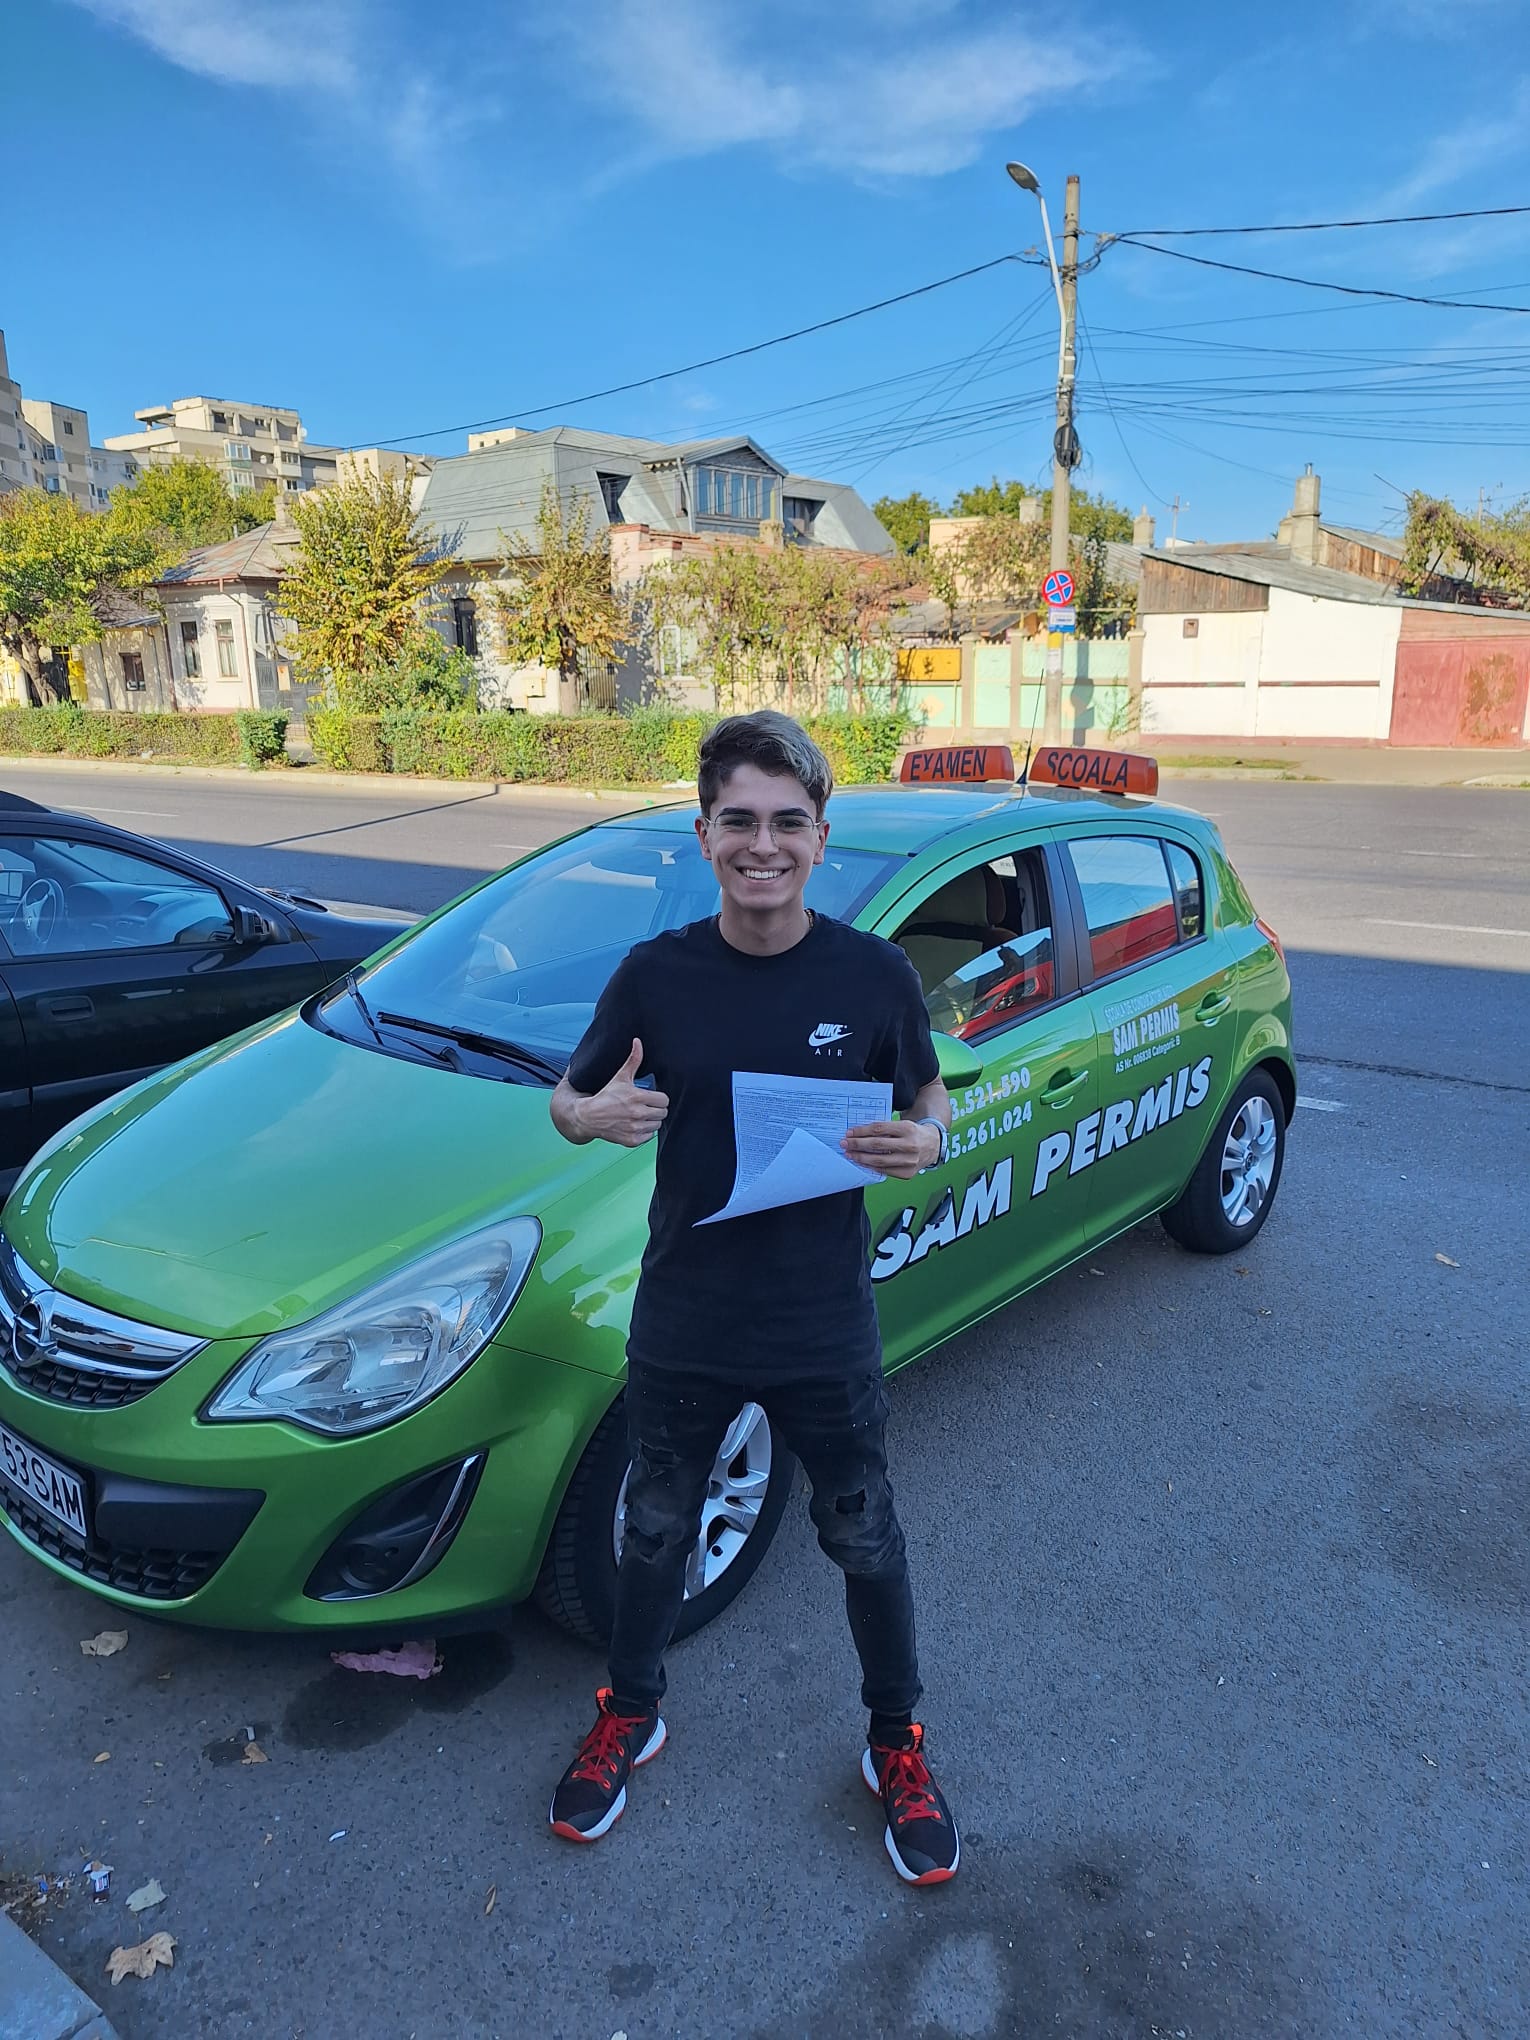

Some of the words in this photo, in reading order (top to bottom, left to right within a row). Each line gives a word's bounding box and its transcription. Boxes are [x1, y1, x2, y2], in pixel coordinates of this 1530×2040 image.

[910, 748, 988, 781] EXAMEN
[815, 1022, 844, 1037] NIKE
[1113, 1020, 1139, 1057] SAM
[1140, 1002, 1180, 1045] PERMIS
[870, 1155, 1014, 1281] SAM
[1031, 1056, 1213, 1198] PERMIS
